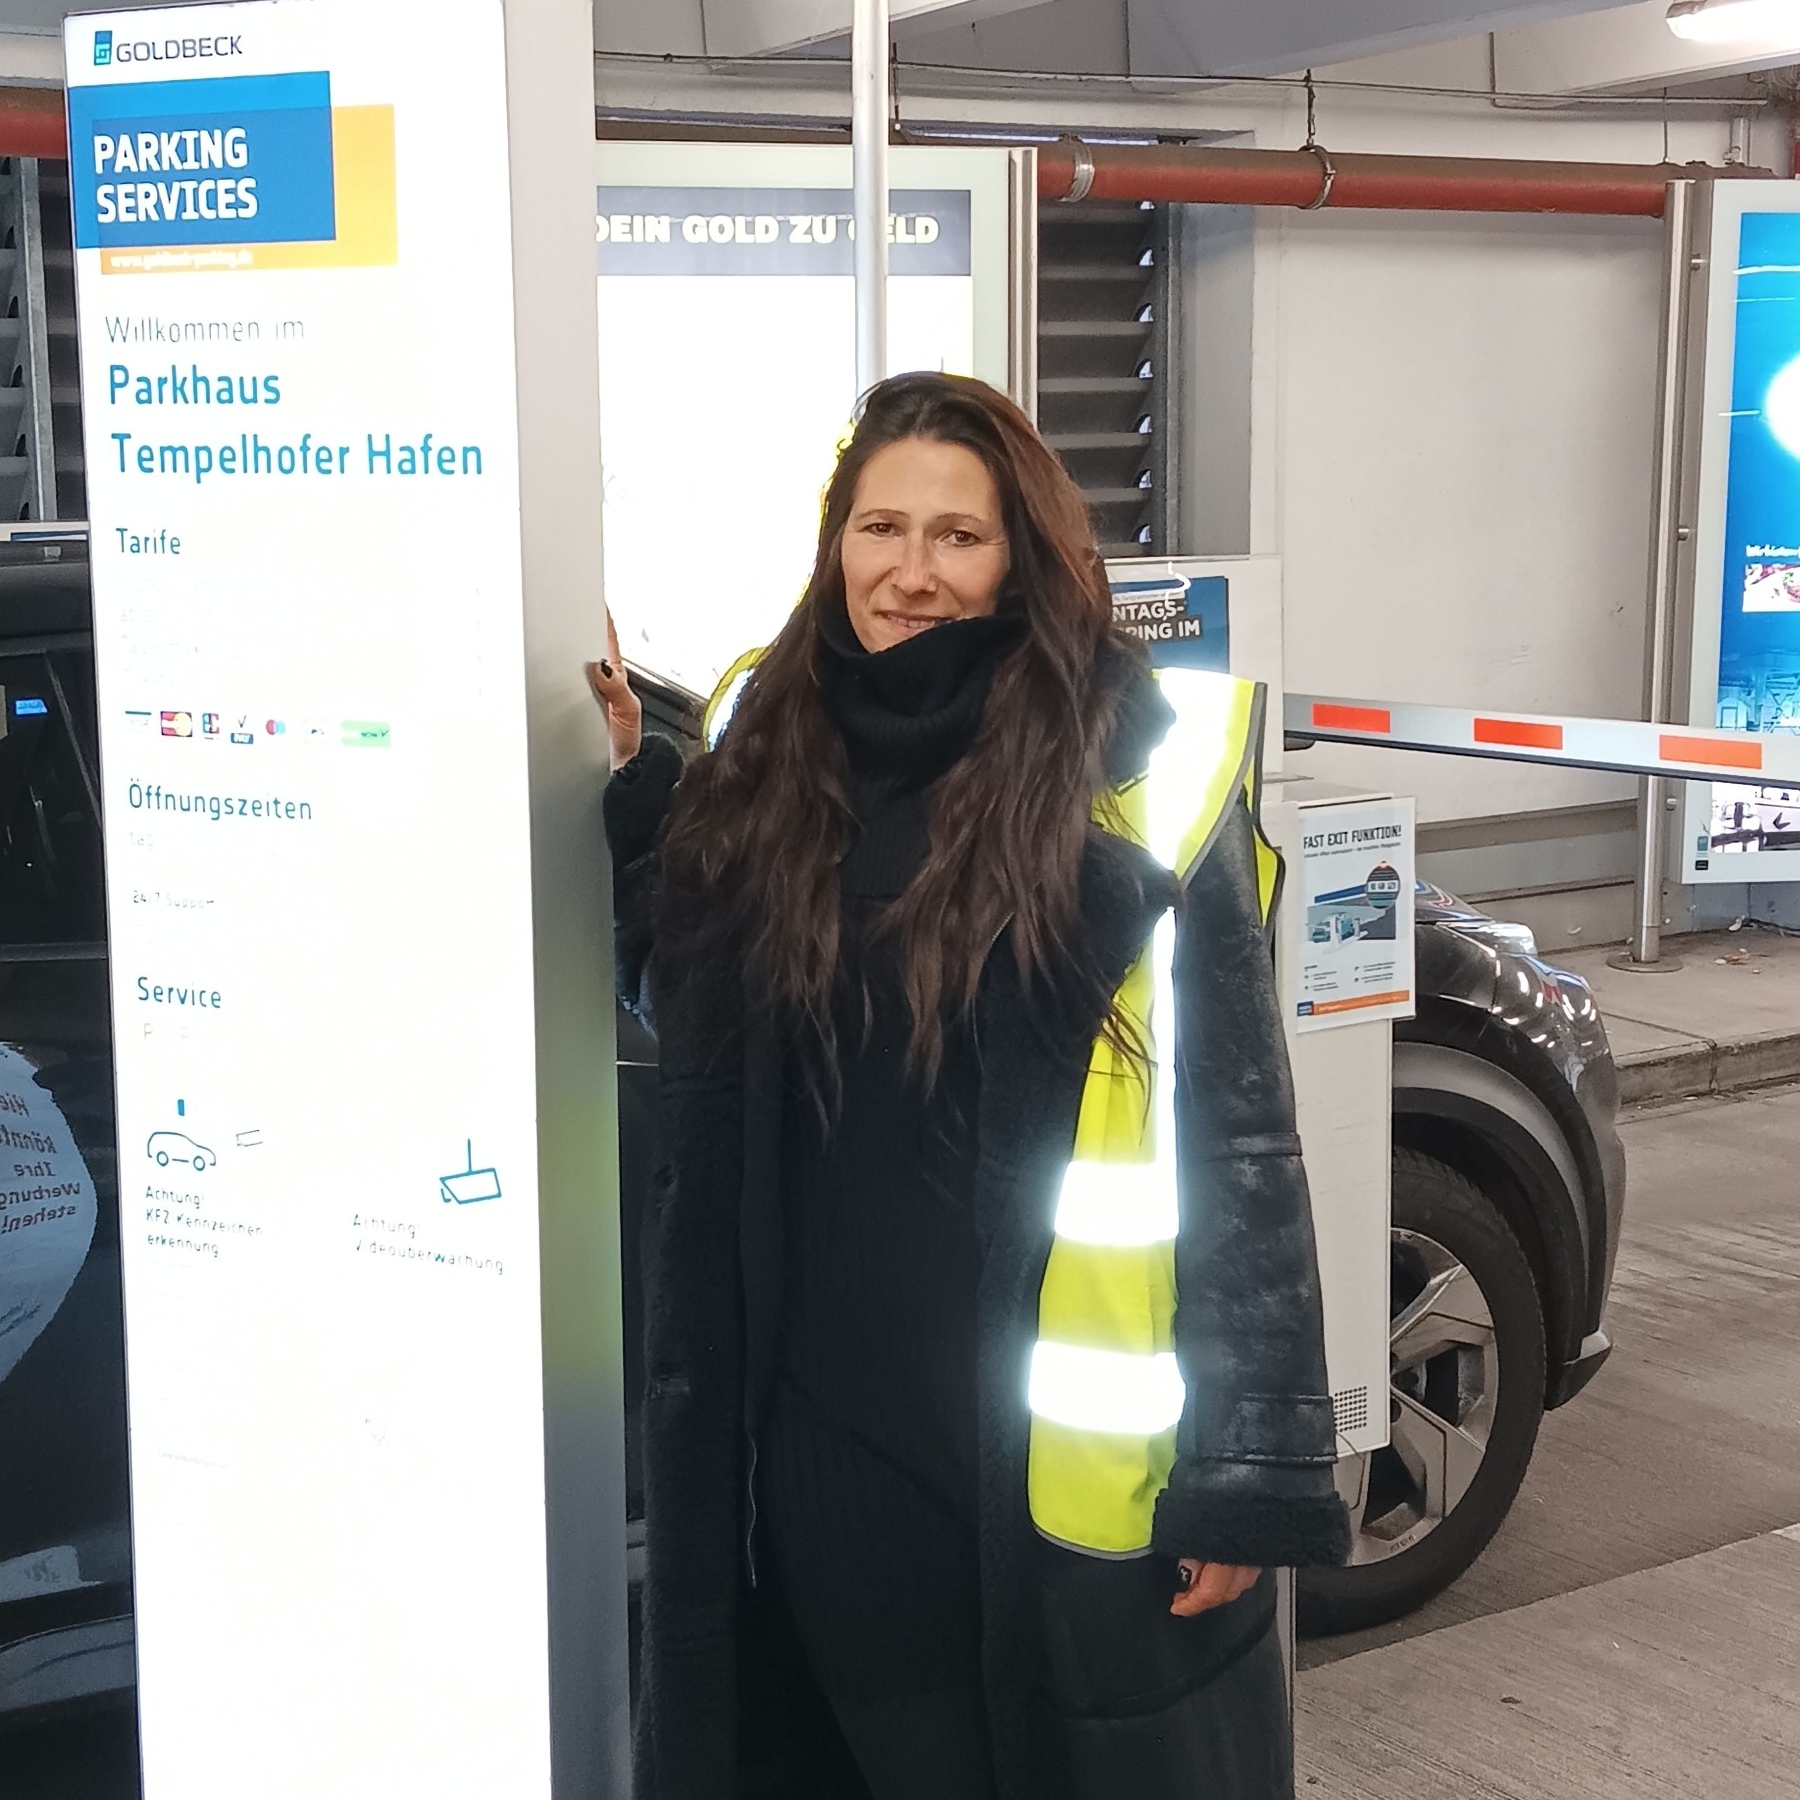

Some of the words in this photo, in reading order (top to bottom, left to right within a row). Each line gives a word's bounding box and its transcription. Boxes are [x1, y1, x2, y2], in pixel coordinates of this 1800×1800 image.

[116, 35, 243, 63] GOLDBECK
[94, 127, 249, 174] PARKING
[96, 178, 259, 223] SERVICES
[682, 215, 780, 245] GOLD
[789, 215, 837, 245] ZU
[104, 316, 261, 343] Willkommen
[275, 320, 305, 341] im
[109, 364, 281, 405] Parkhaus
[110, 432, 350, 484] Tempelhofer
[367, 433, 483, 476] Hafen
[115, 527, 182, 556] Tarife
[1118, 621, 1173, 641] PING
[1178, 619, 1201, 637] IM
[128, 777, 312, 821] Öffnungszeiten
[1303, 833, 1325, 850] FAST
[1327, 831, 1349, 846] EXIT
[1351, 825, 1402, 843] FUNKTION!
[137, 976, 222, 1009] Service
